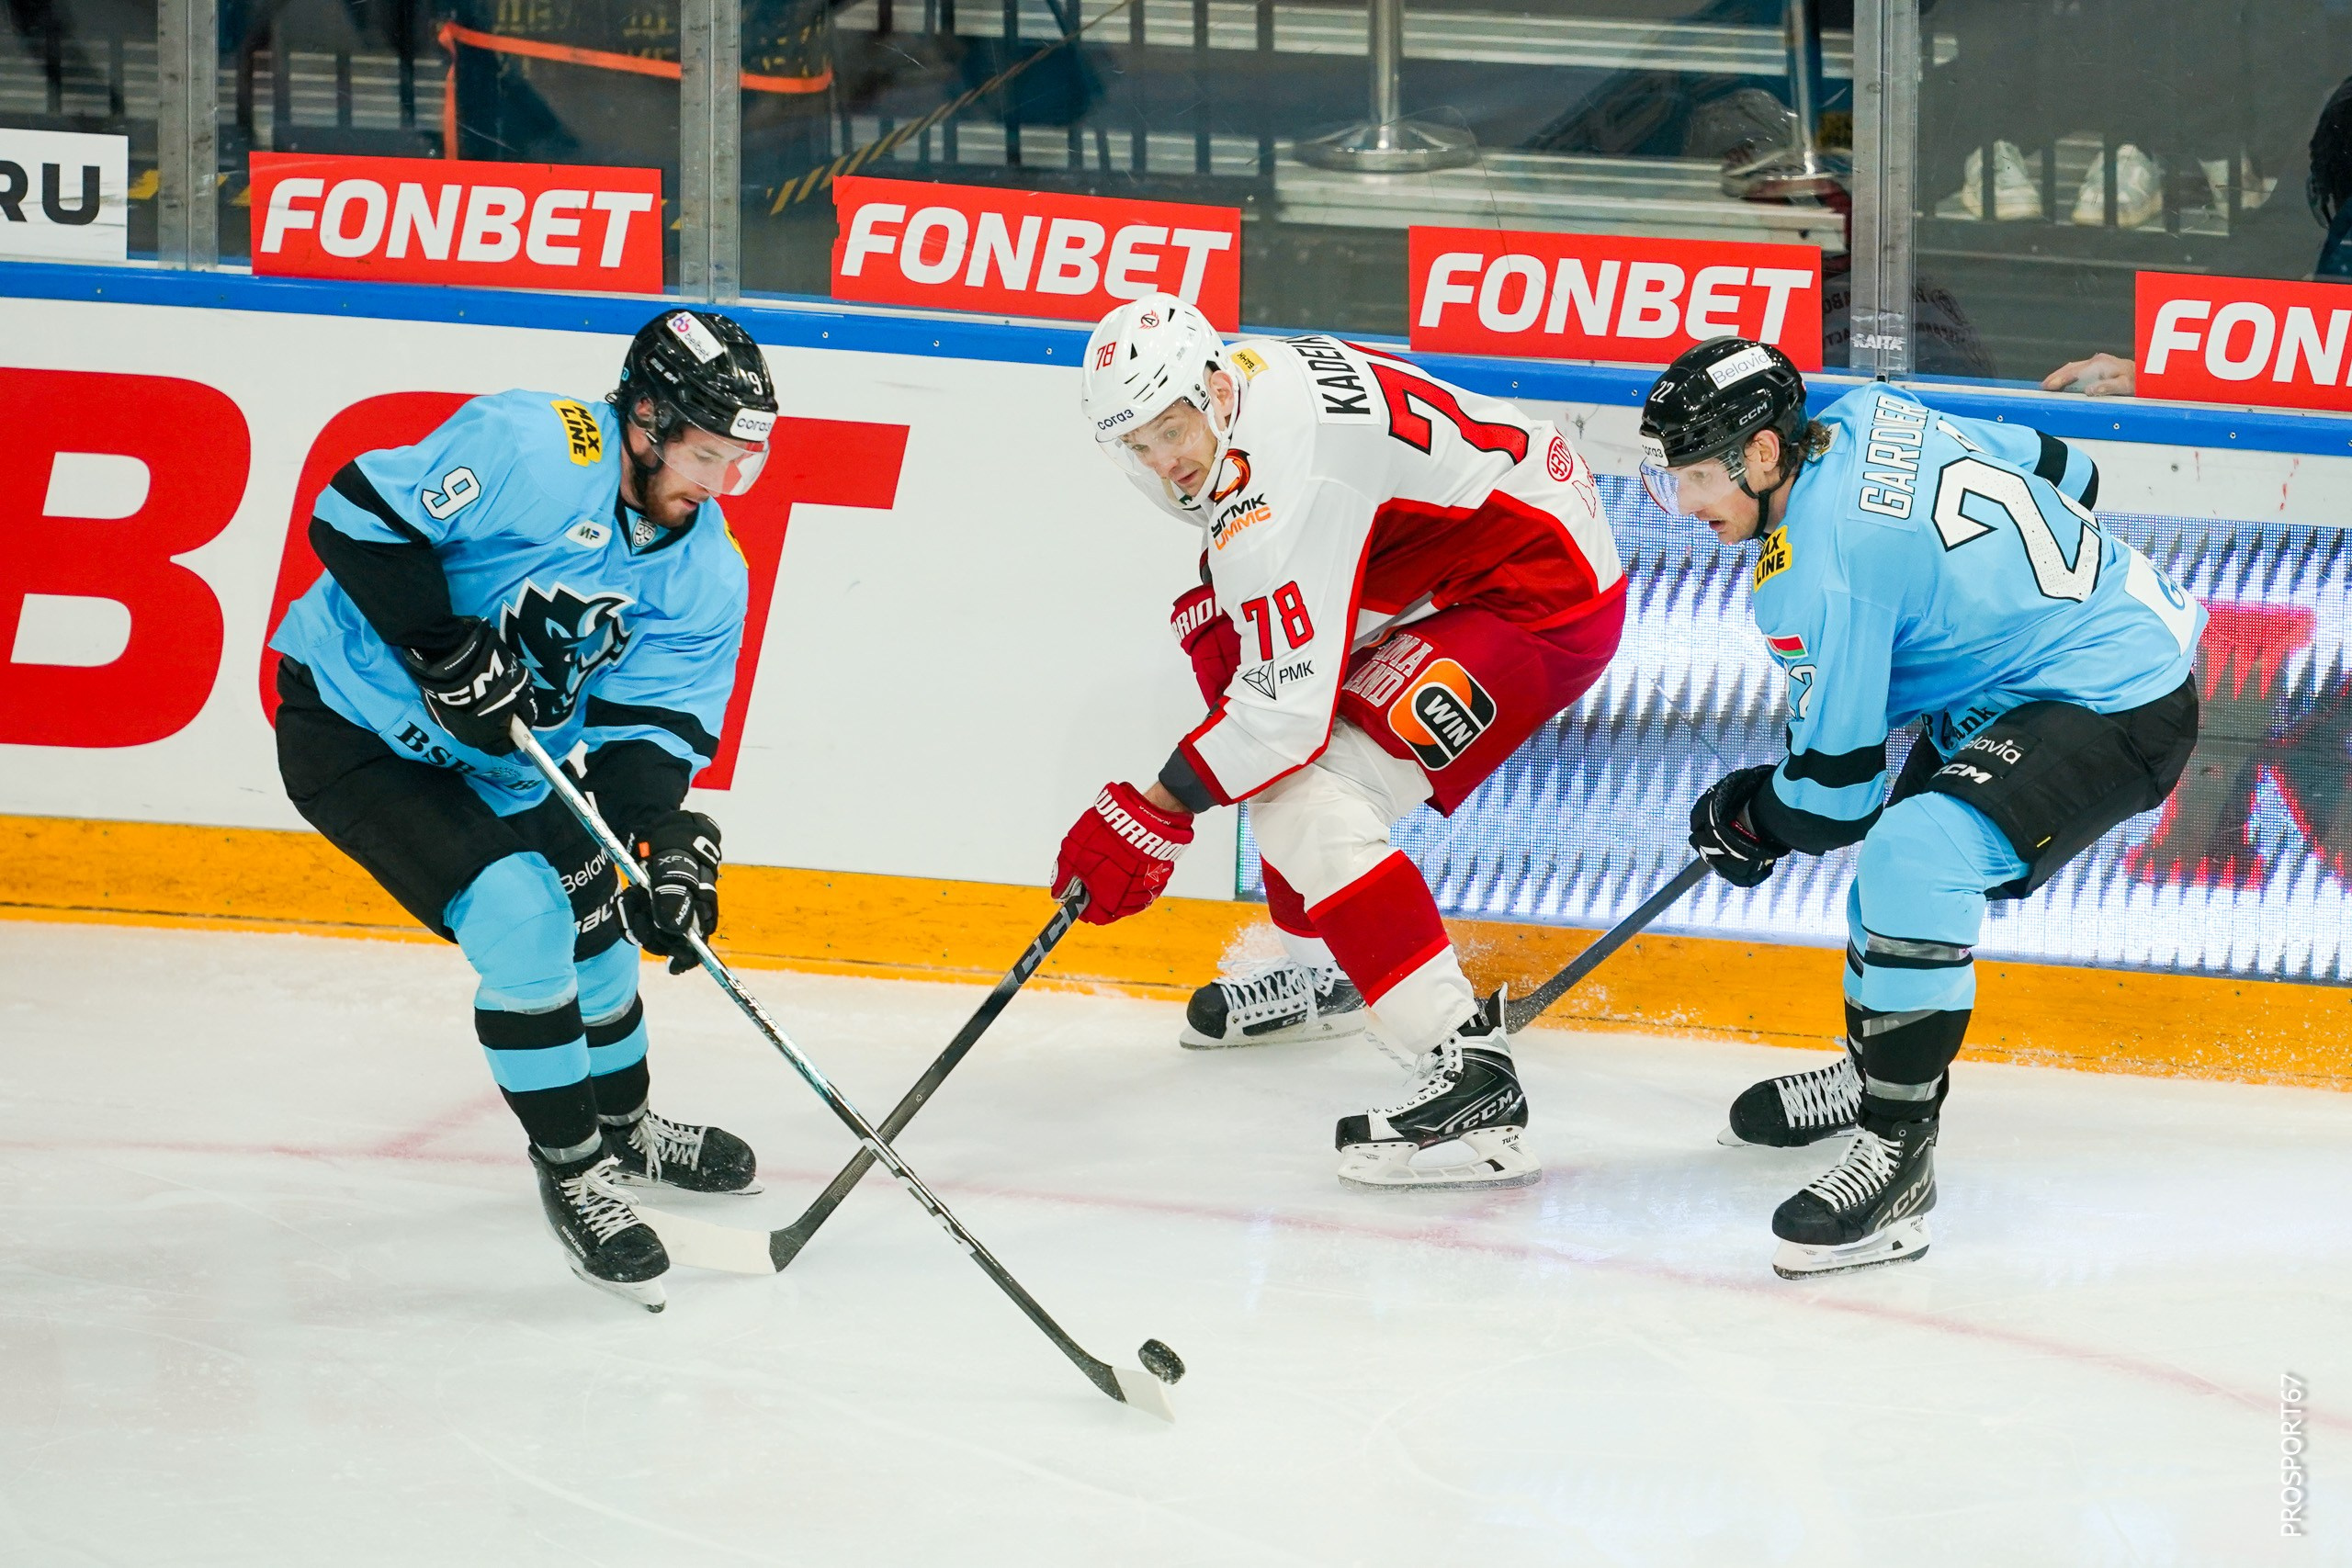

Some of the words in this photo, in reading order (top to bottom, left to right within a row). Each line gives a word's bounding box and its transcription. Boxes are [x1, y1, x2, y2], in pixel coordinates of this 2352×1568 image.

[260, 178, 653, 268] FONBET
[841, 203, 1232, 305] FONBET
[1419, 253, 1814, 344] FONBET
[1096, 342, 1116, 371] 78
[2144, 299, 2352, 387] FON
[747, 371, 763, 395] 9
[1650, 380, 1674, 403] 22
[1712, 353, 1770, 384] Belavia
[560, 407, 586, 458] LINE
[573, 405, 600, 454] MAX
[1738, 401, 1768, 426] CCM
[421, 467, 481, 520] 9
[1211, 493, 1267, 538] УГМК
[1215, 505, 1272, 550] UMMC
[1756, 551, 1785, 585] LINE
[1241, 581, 1314, 661] 78
[1424, 694, 1474, 748] WIN
[1462, 1090, 1513, 1130] CCM
[1874, 1170, 1928, 1232] CCM
